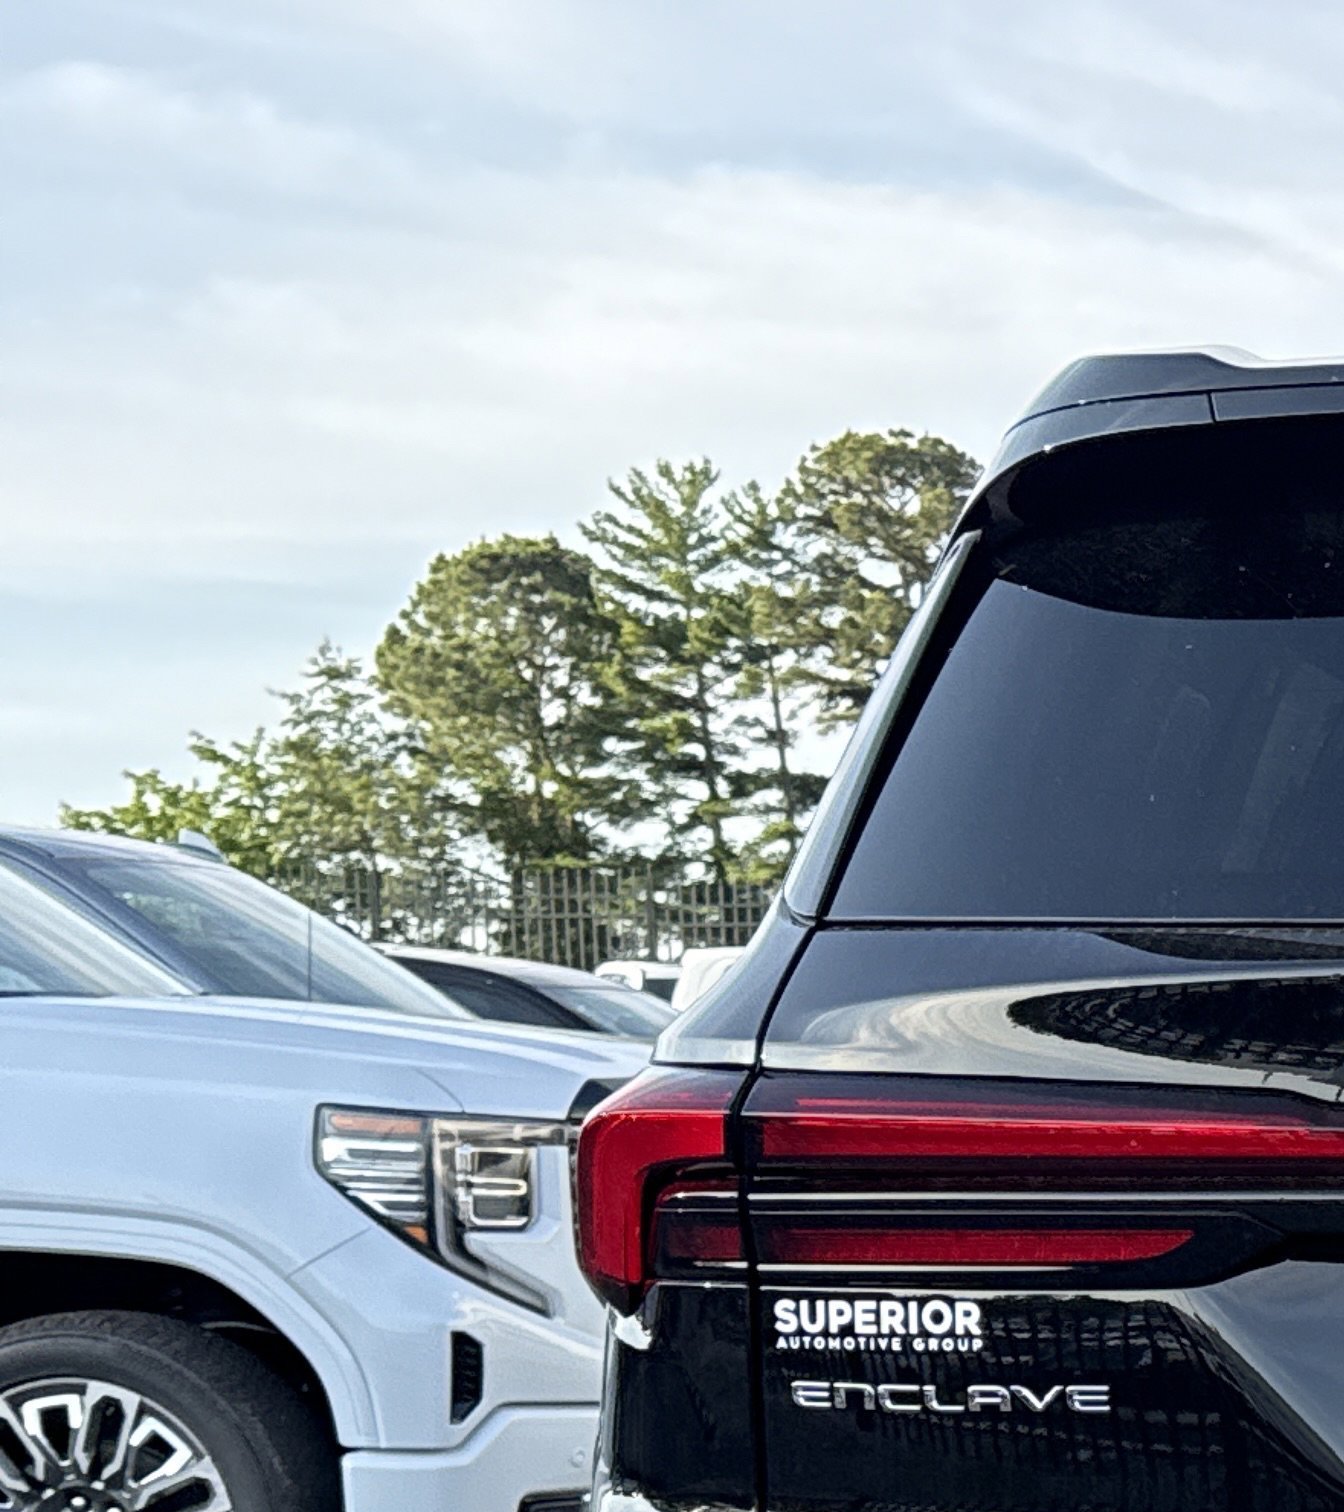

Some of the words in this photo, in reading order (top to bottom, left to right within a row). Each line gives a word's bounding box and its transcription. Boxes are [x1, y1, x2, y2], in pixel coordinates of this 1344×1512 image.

[773, 1298, 982, 1335] SUPERIOR
[775, 1336, 902, 1351] AUTOMOTIVE
[912, 1336, 983, 1352] GROUP
[791, 1381, 1111, 1412] ENCLAVE
